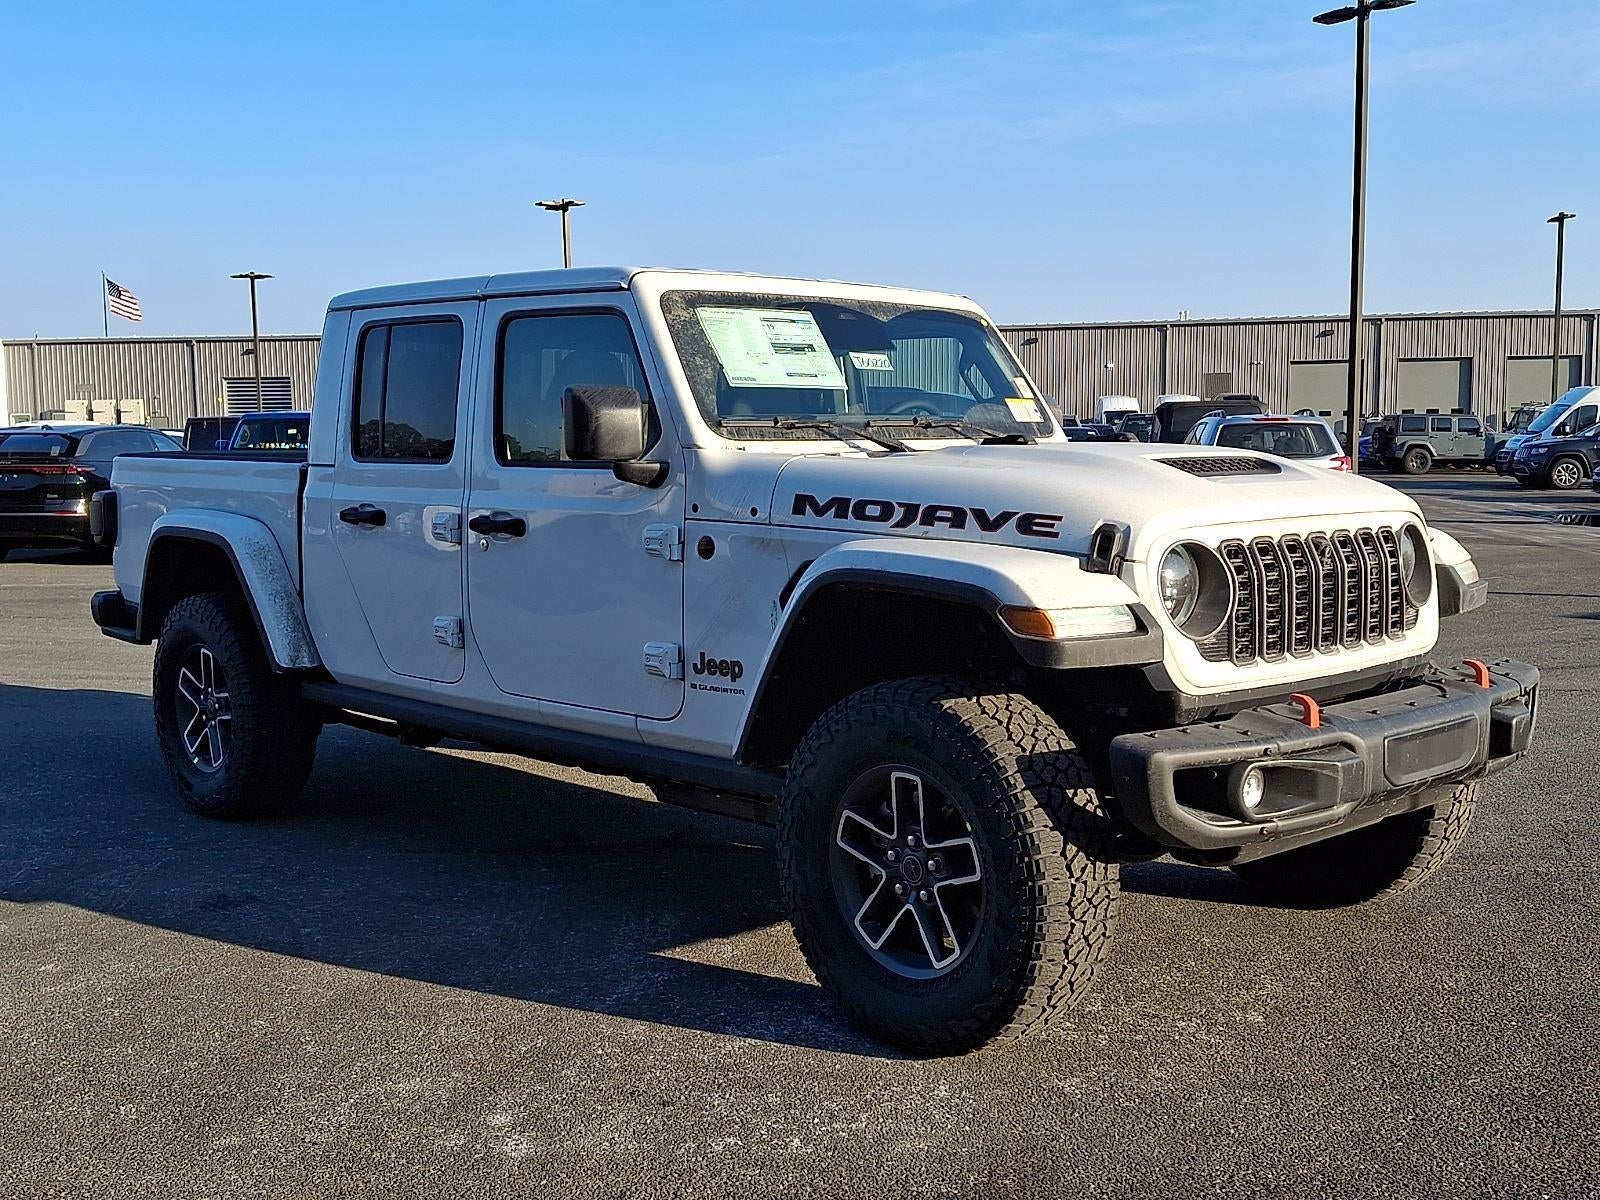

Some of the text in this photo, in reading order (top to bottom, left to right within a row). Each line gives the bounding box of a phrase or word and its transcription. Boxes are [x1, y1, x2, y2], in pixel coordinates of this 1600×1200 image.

[791, 493, 1064, 539] MOJAVE
[692, 651, 744, 682] Jeep
[698, 683, 746, 696] GLADIATOR
